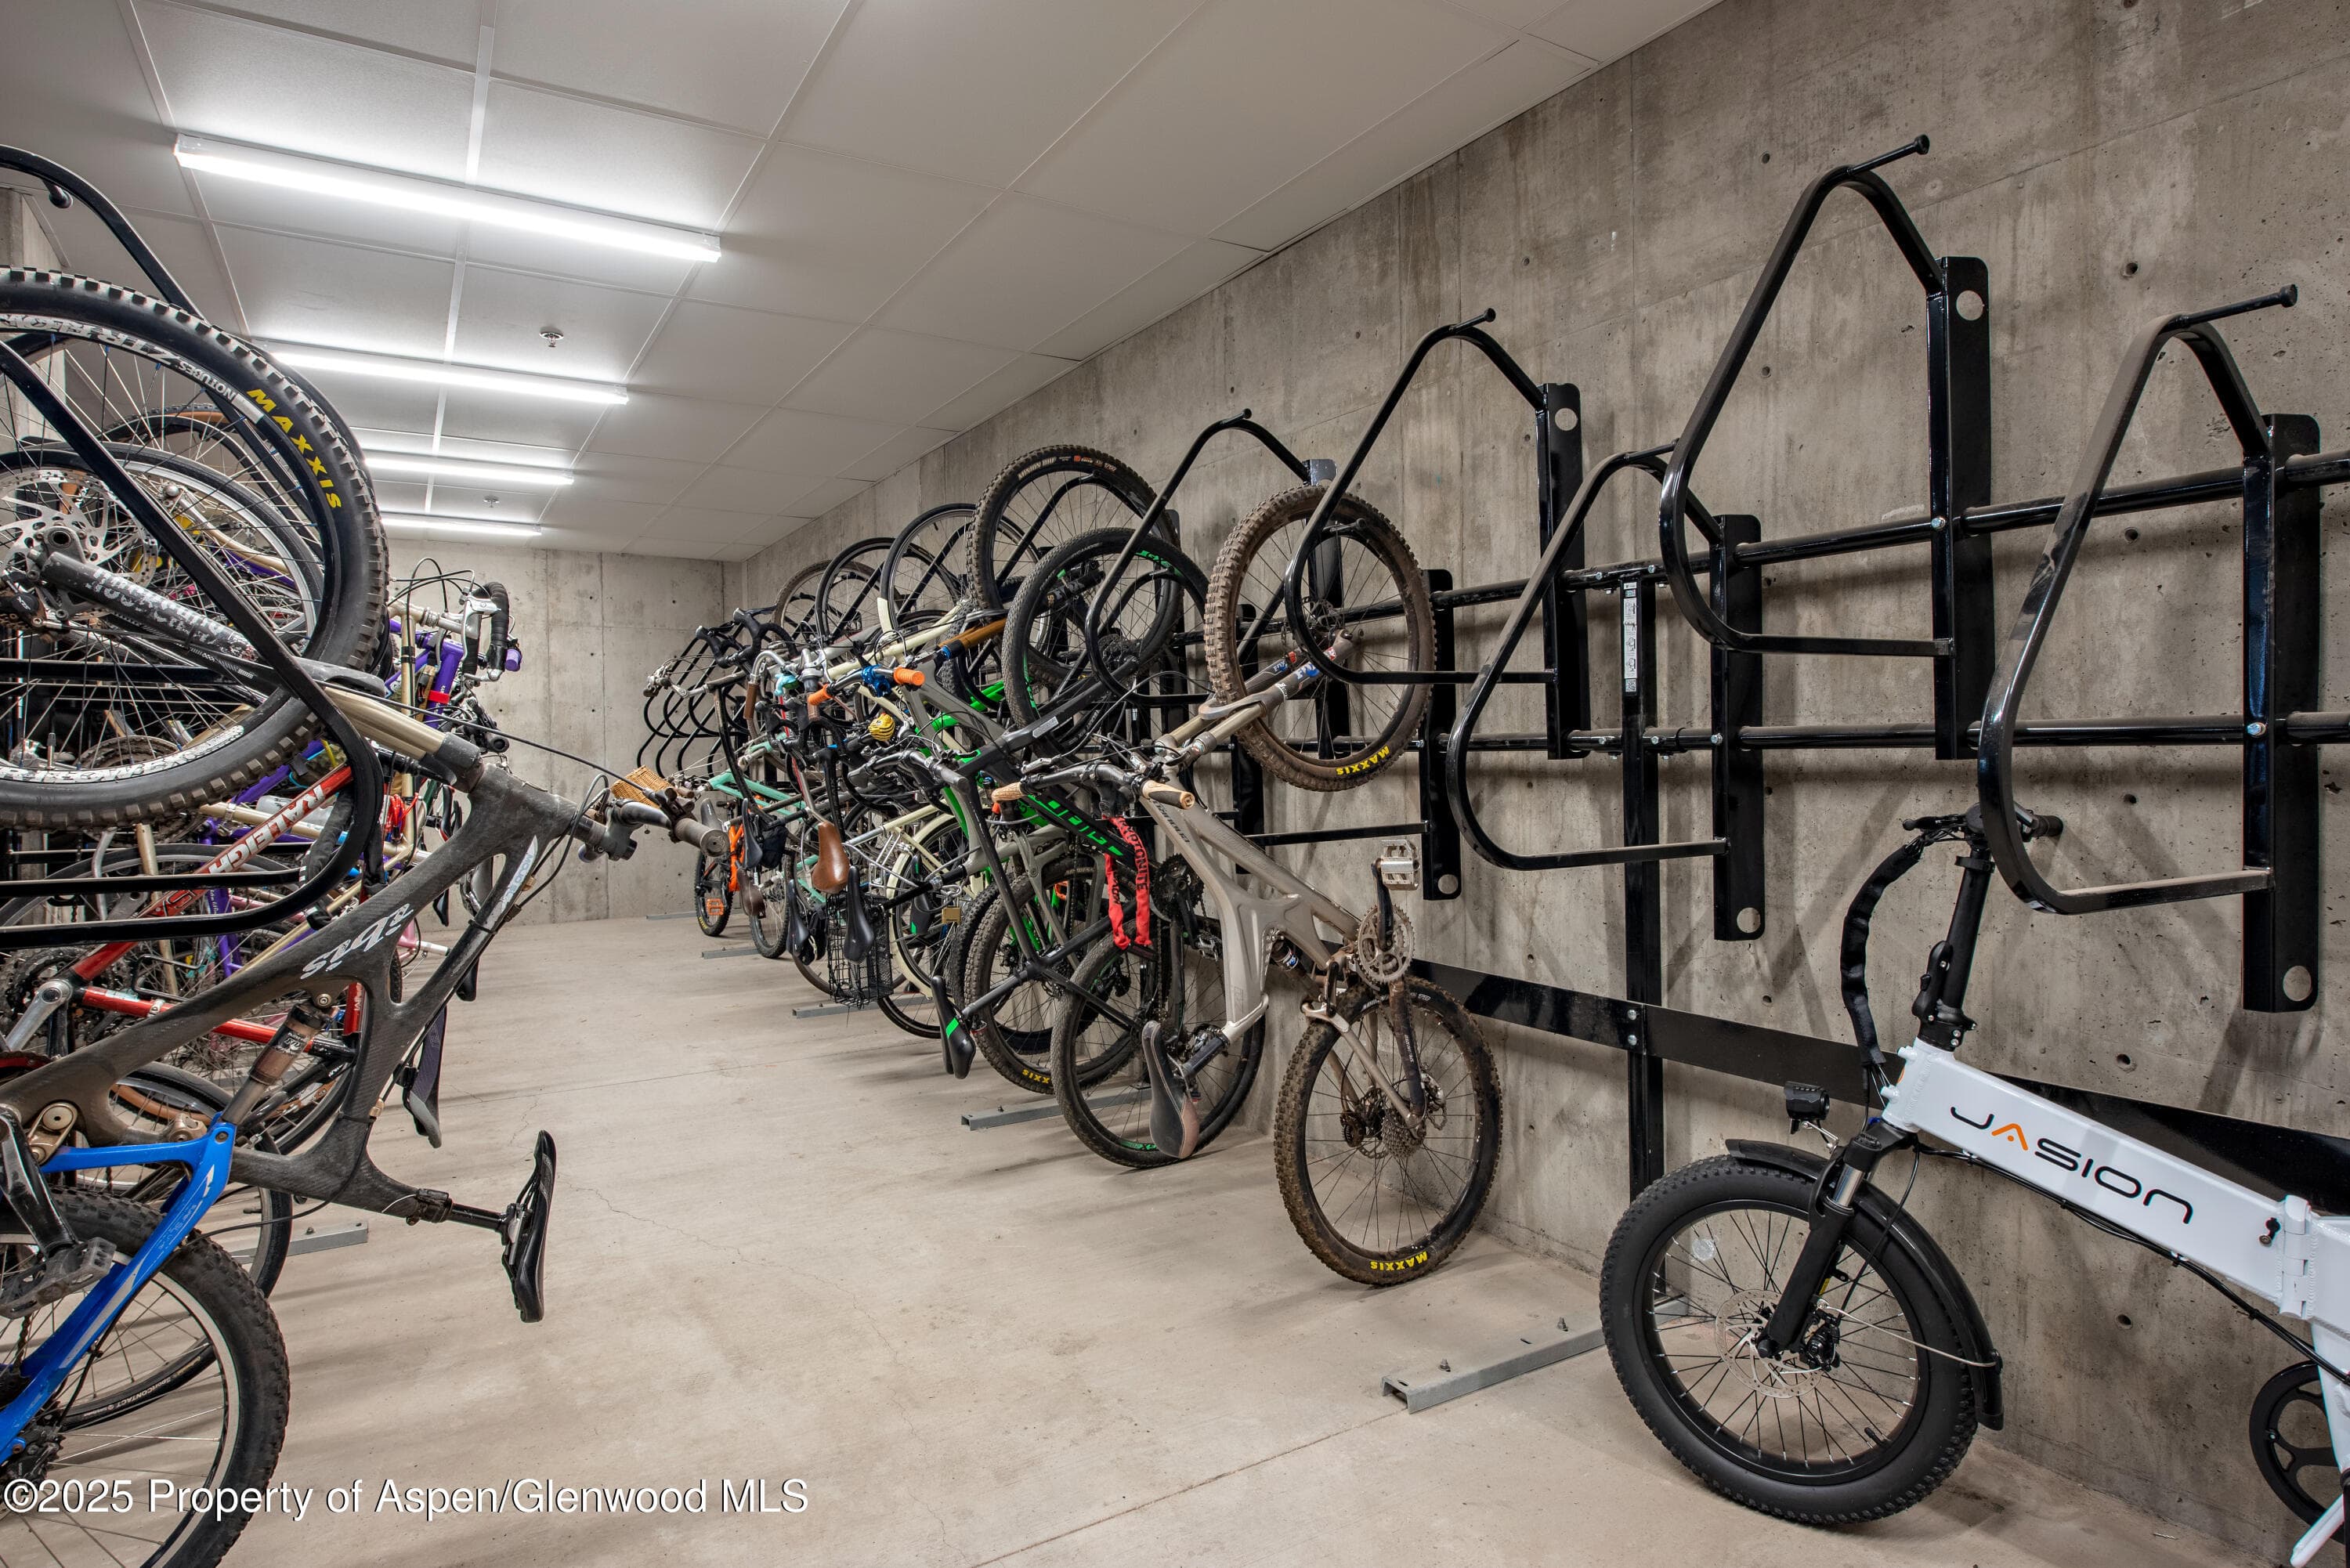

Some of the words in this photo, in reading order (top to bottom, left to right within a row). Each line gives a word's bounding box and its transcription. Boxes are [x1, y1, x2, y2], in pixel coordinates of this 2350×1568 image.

[178, 359, 237, 403] NOTUBES
[247, 388, 342, 508] MAXXIS
[1336, 745, 1390, 775] MAXXIS
[208, 785, 326, 874] RALEIGH
[300, 903, 414, 980] ibis
[1021, 1068, 1050, 1084] XXIS
[1950, 1106, 2194, 1225] JASION
[1369, 1250, 1428, 1271] MAXXIS
